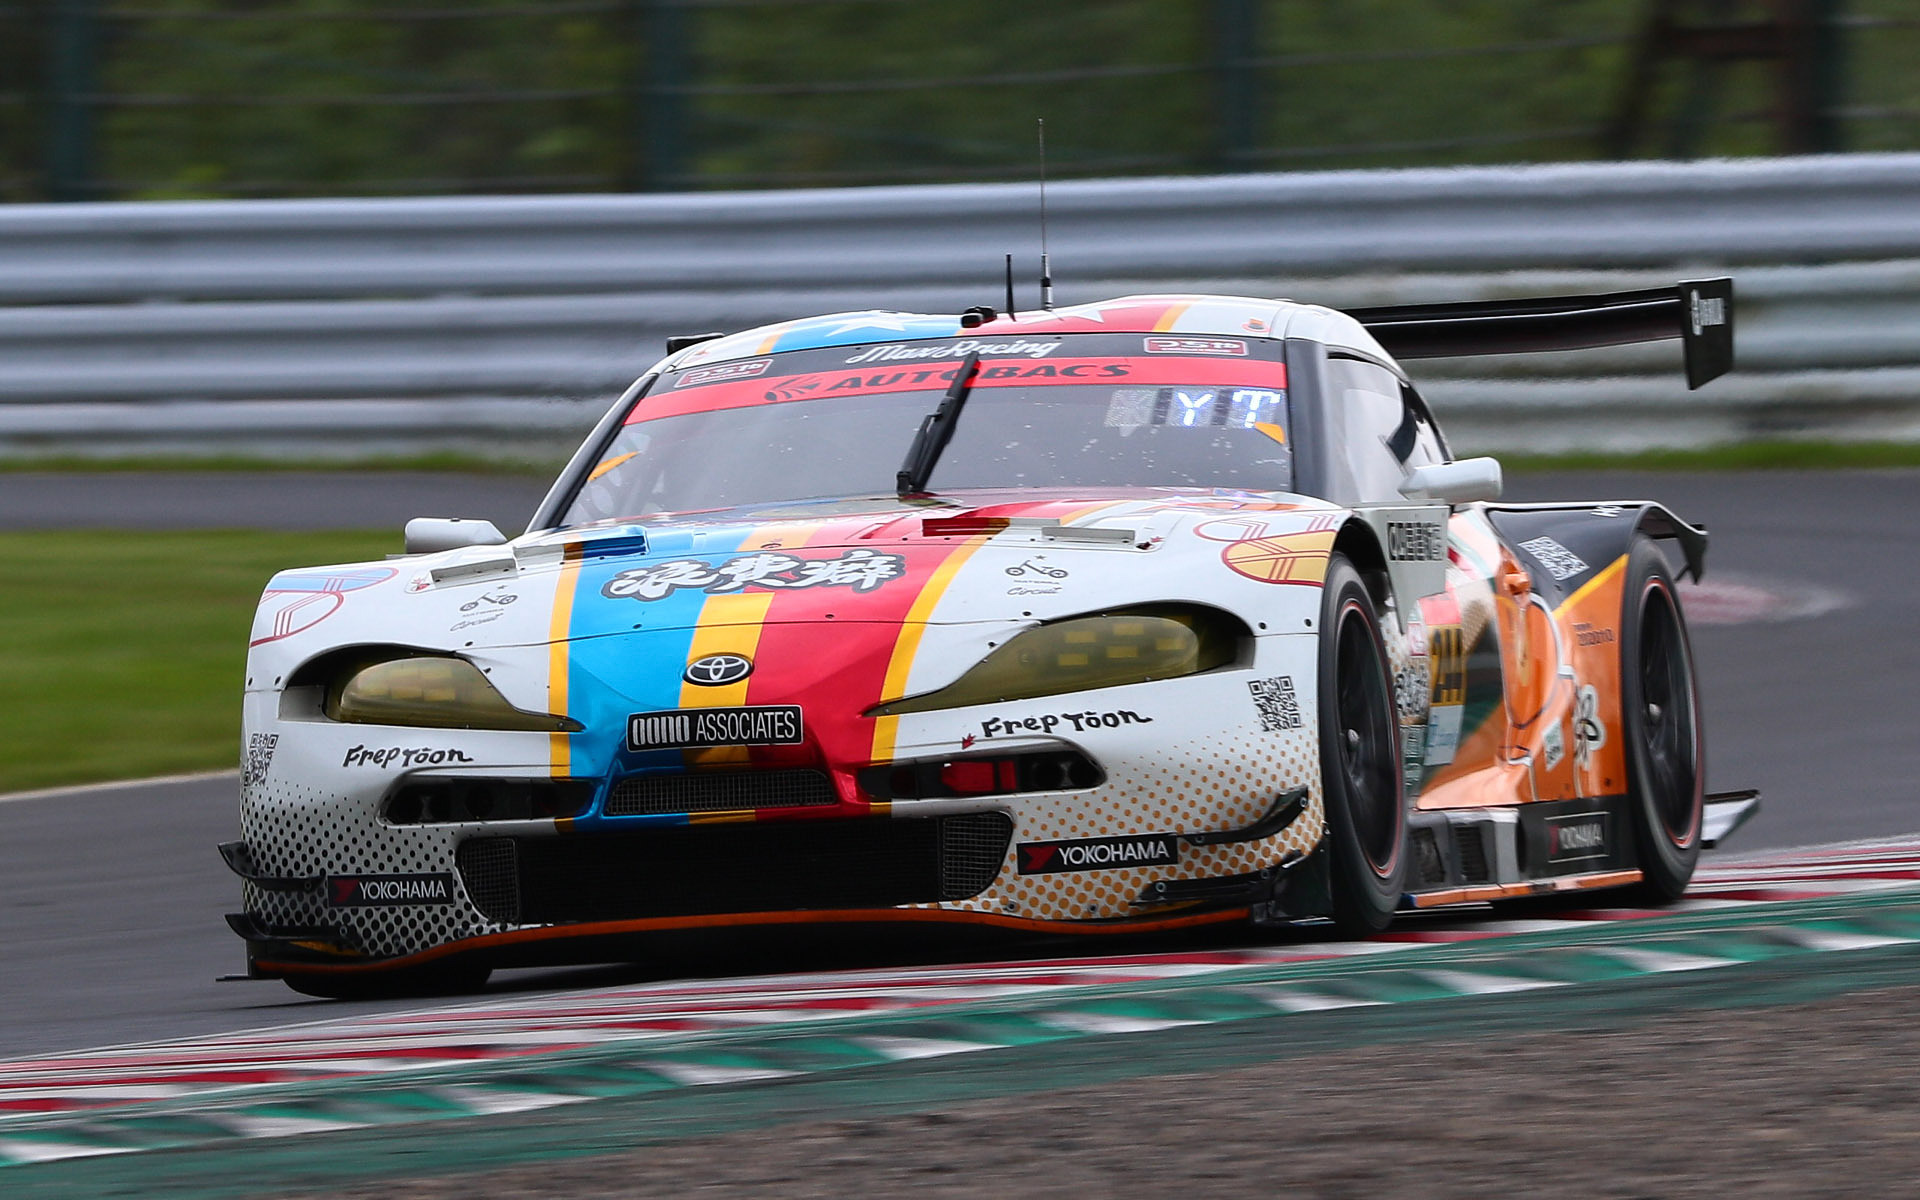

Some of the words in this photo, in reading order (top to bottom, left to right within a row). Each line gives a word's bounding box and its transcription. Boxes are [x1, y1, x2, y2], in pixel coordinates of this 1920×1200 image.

[827, 364, 1132, 392] AUTOBACS
[695, 711, 796, 743] ASSOCIATES
[981, 715, 1060, 738] Frep
[342, 744, 401, 769] Frep
[1057, 840, 1171, 866] YOKOHAMA
[359, 879, 447, 900] YOKOHAMA
